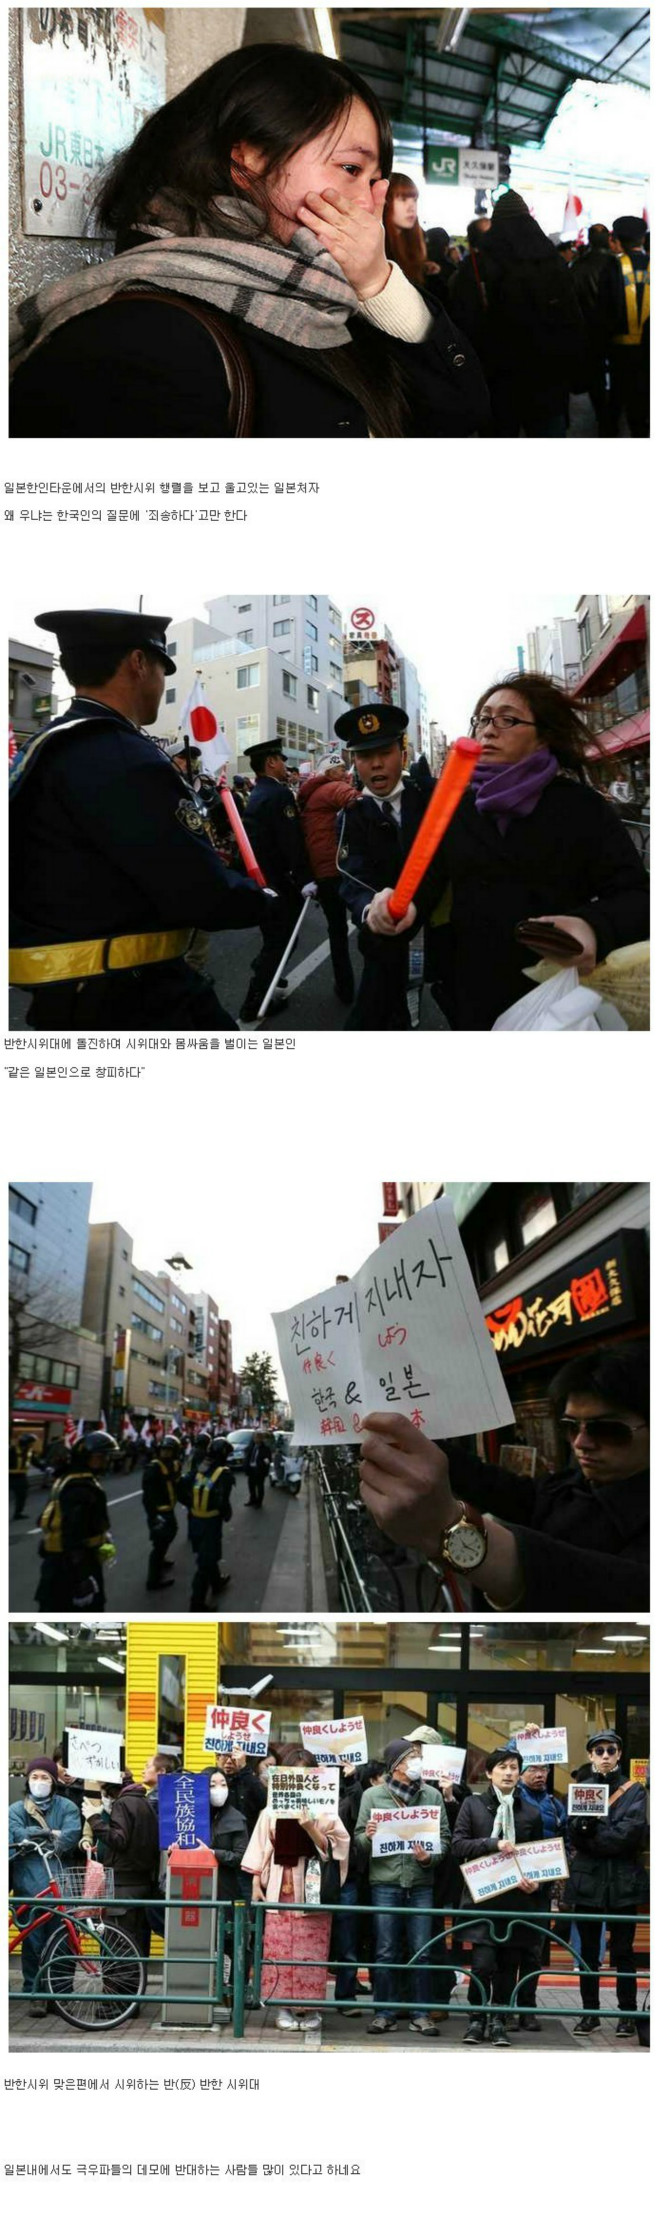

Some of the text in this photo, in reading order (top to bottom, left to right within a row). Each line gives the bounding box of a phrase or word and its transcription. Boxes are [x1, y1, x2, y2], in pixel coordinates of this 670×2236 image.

[432, 158, 456, 173] JR
[290, 1238, 453, 1356] 친하게 지내자
[311, 1364, 430, 1413] 한국 & 일본
[211, 1708, 266, 1733] 仲良く
[303, 1720, 363, 1735] 仲良くしようぜ
[574, 1788, 603, 1800] 仲良く
[174, 1775, 195, 1846] 全民族協和
[373, 1809, 439, 1823] 仲良くしようぜ
[380, 1840, 405, 1853] 친하게
